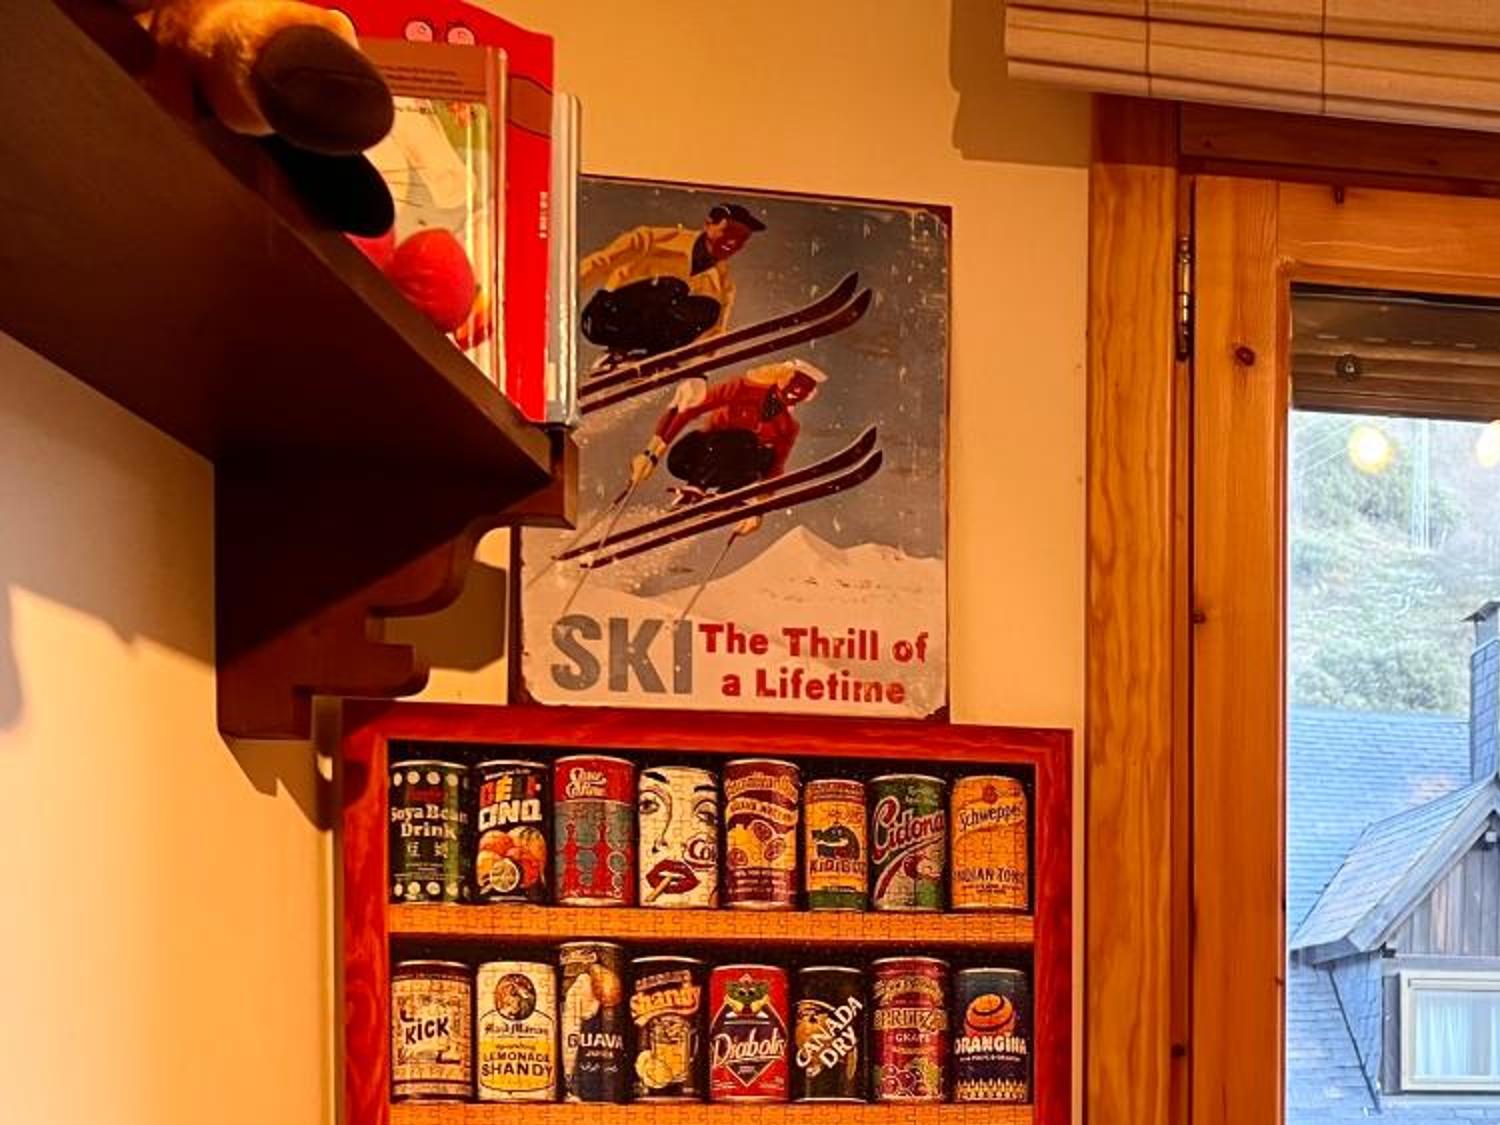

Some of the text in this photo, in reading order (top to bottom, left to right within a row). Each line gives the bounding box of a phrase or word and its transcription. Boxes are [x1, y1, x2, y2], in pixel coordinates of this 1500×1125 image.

[549, 614, 692, 695] SKI
[699, 622, 928, 663] The Thrill of
[721, 669, 905, 704] a Lifetime
[400, 821, 457, 840] Drink
[796, 996, 863, 1068] CANADA
[820, 1027, 860, 1070] DRY
[481, 1063, 553, 1077] SHANDY
